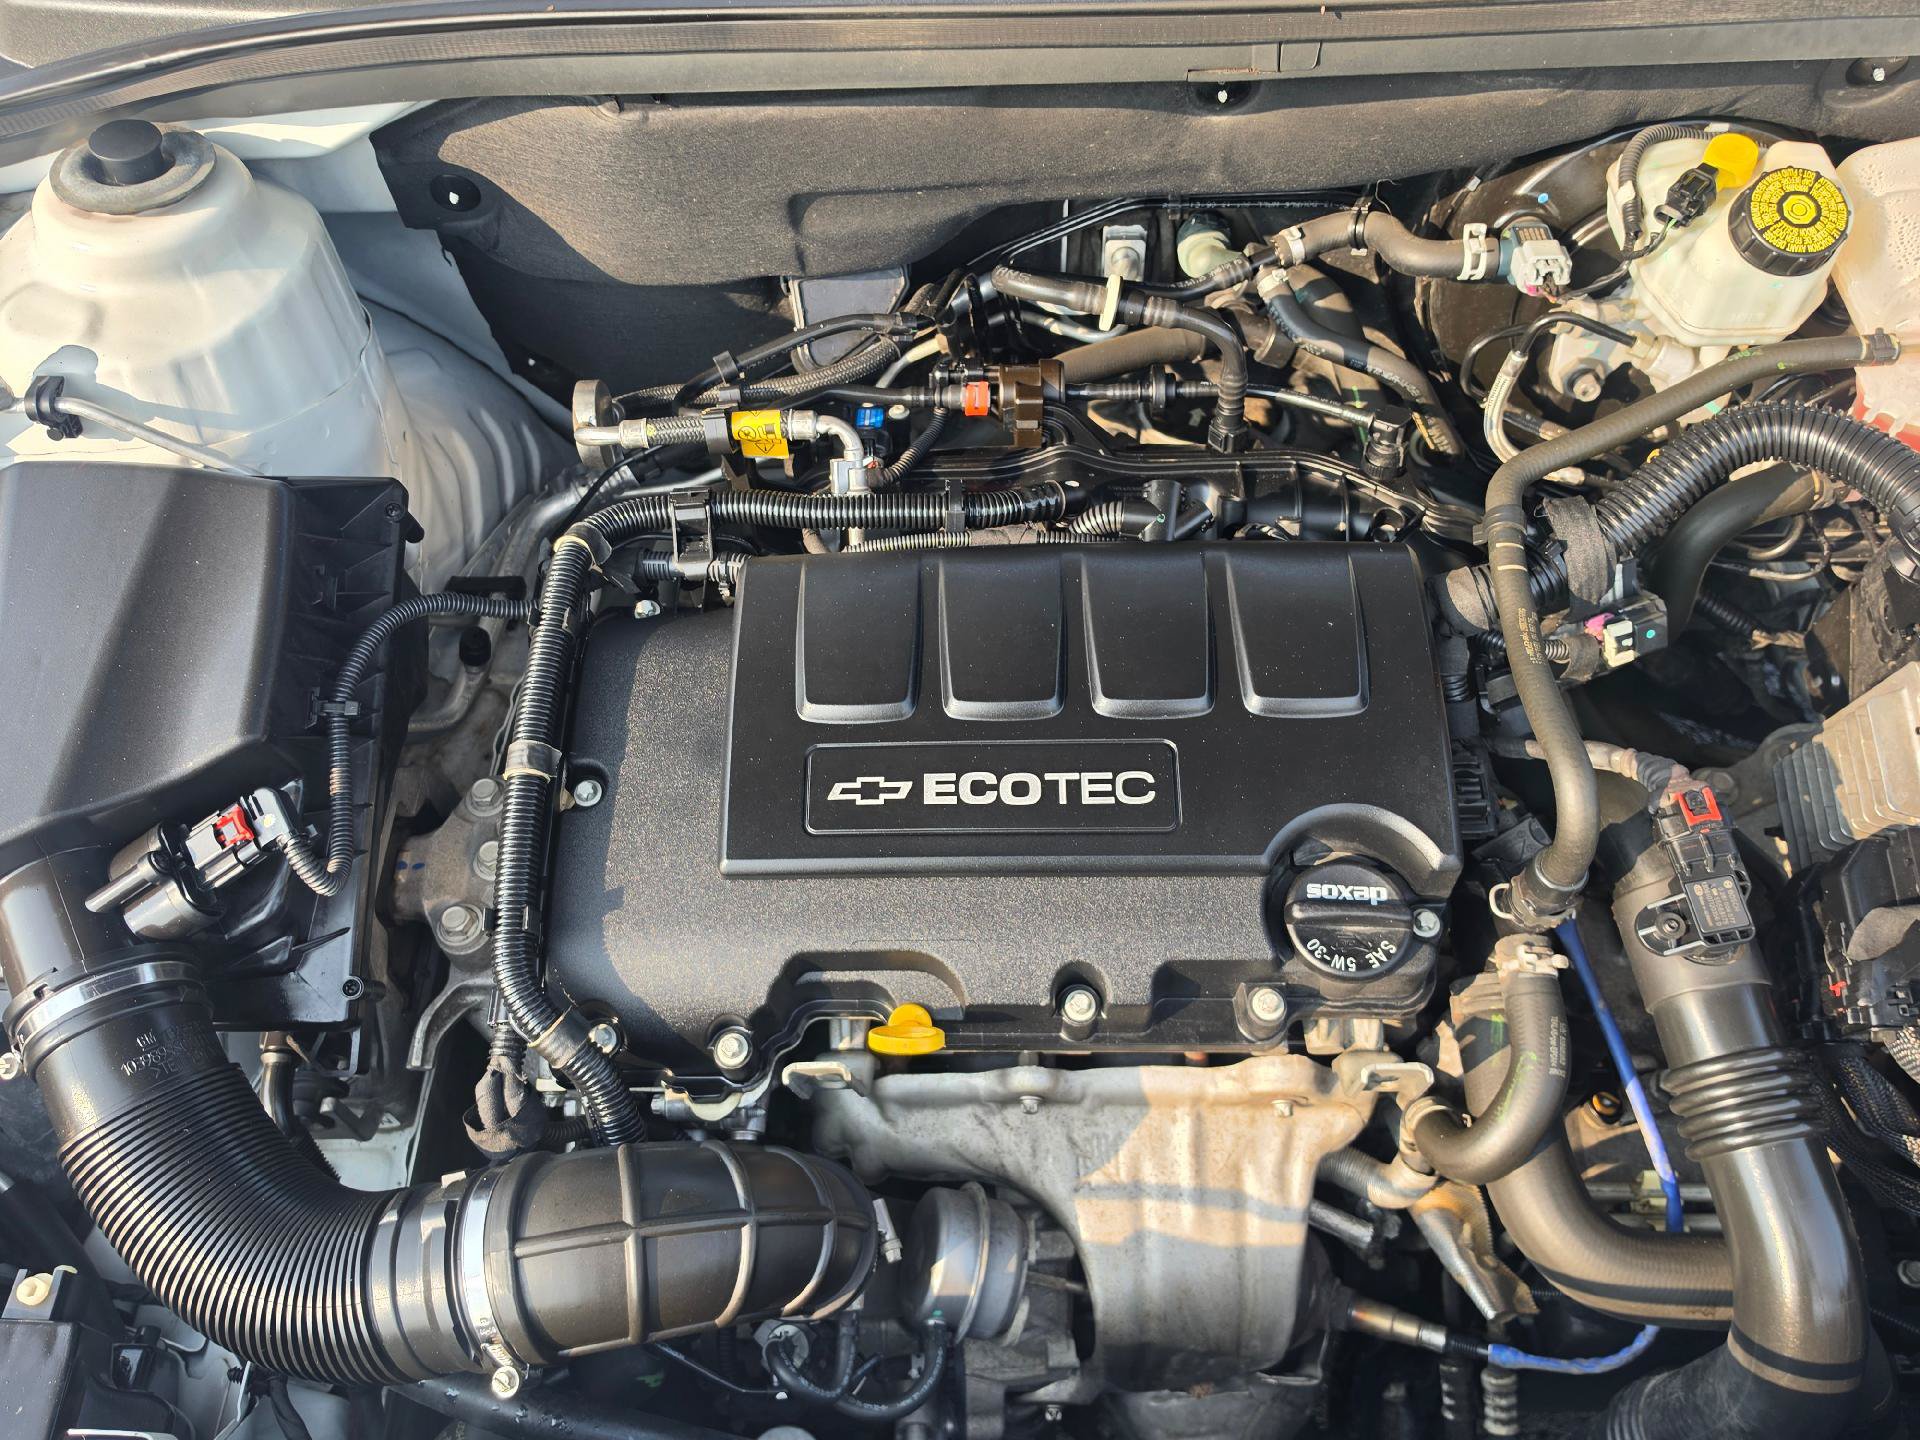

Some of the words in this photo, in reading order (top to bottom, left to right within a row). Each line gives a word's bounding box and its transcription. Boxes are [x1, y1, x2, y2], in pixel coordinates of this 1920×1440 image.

[1764, 171, 1782, 183] FROM
[1780, 169, 1797, 177] FLUID
[1802, 169, 1816, 179] DOT
[1828, 211, 1837, 224] QUE
[1834, 202, 1846, 231] NETTOYER
[1783, 234, 1802, 244] FREIN
[1830, 228, 1841, 239] LE
[1803, 236, 1812, 244] DE
[1806, 235, 1835, 252] BOUCHON
[1785, 243, 1806, 252] AVANT
[923, 771, 1156, 806] ECOTEC
[1306, 883, 1388, 906] dexos
[1306, 938, 1357, 972] 5W-30
[1364, 939, 1398, 969] SAE
